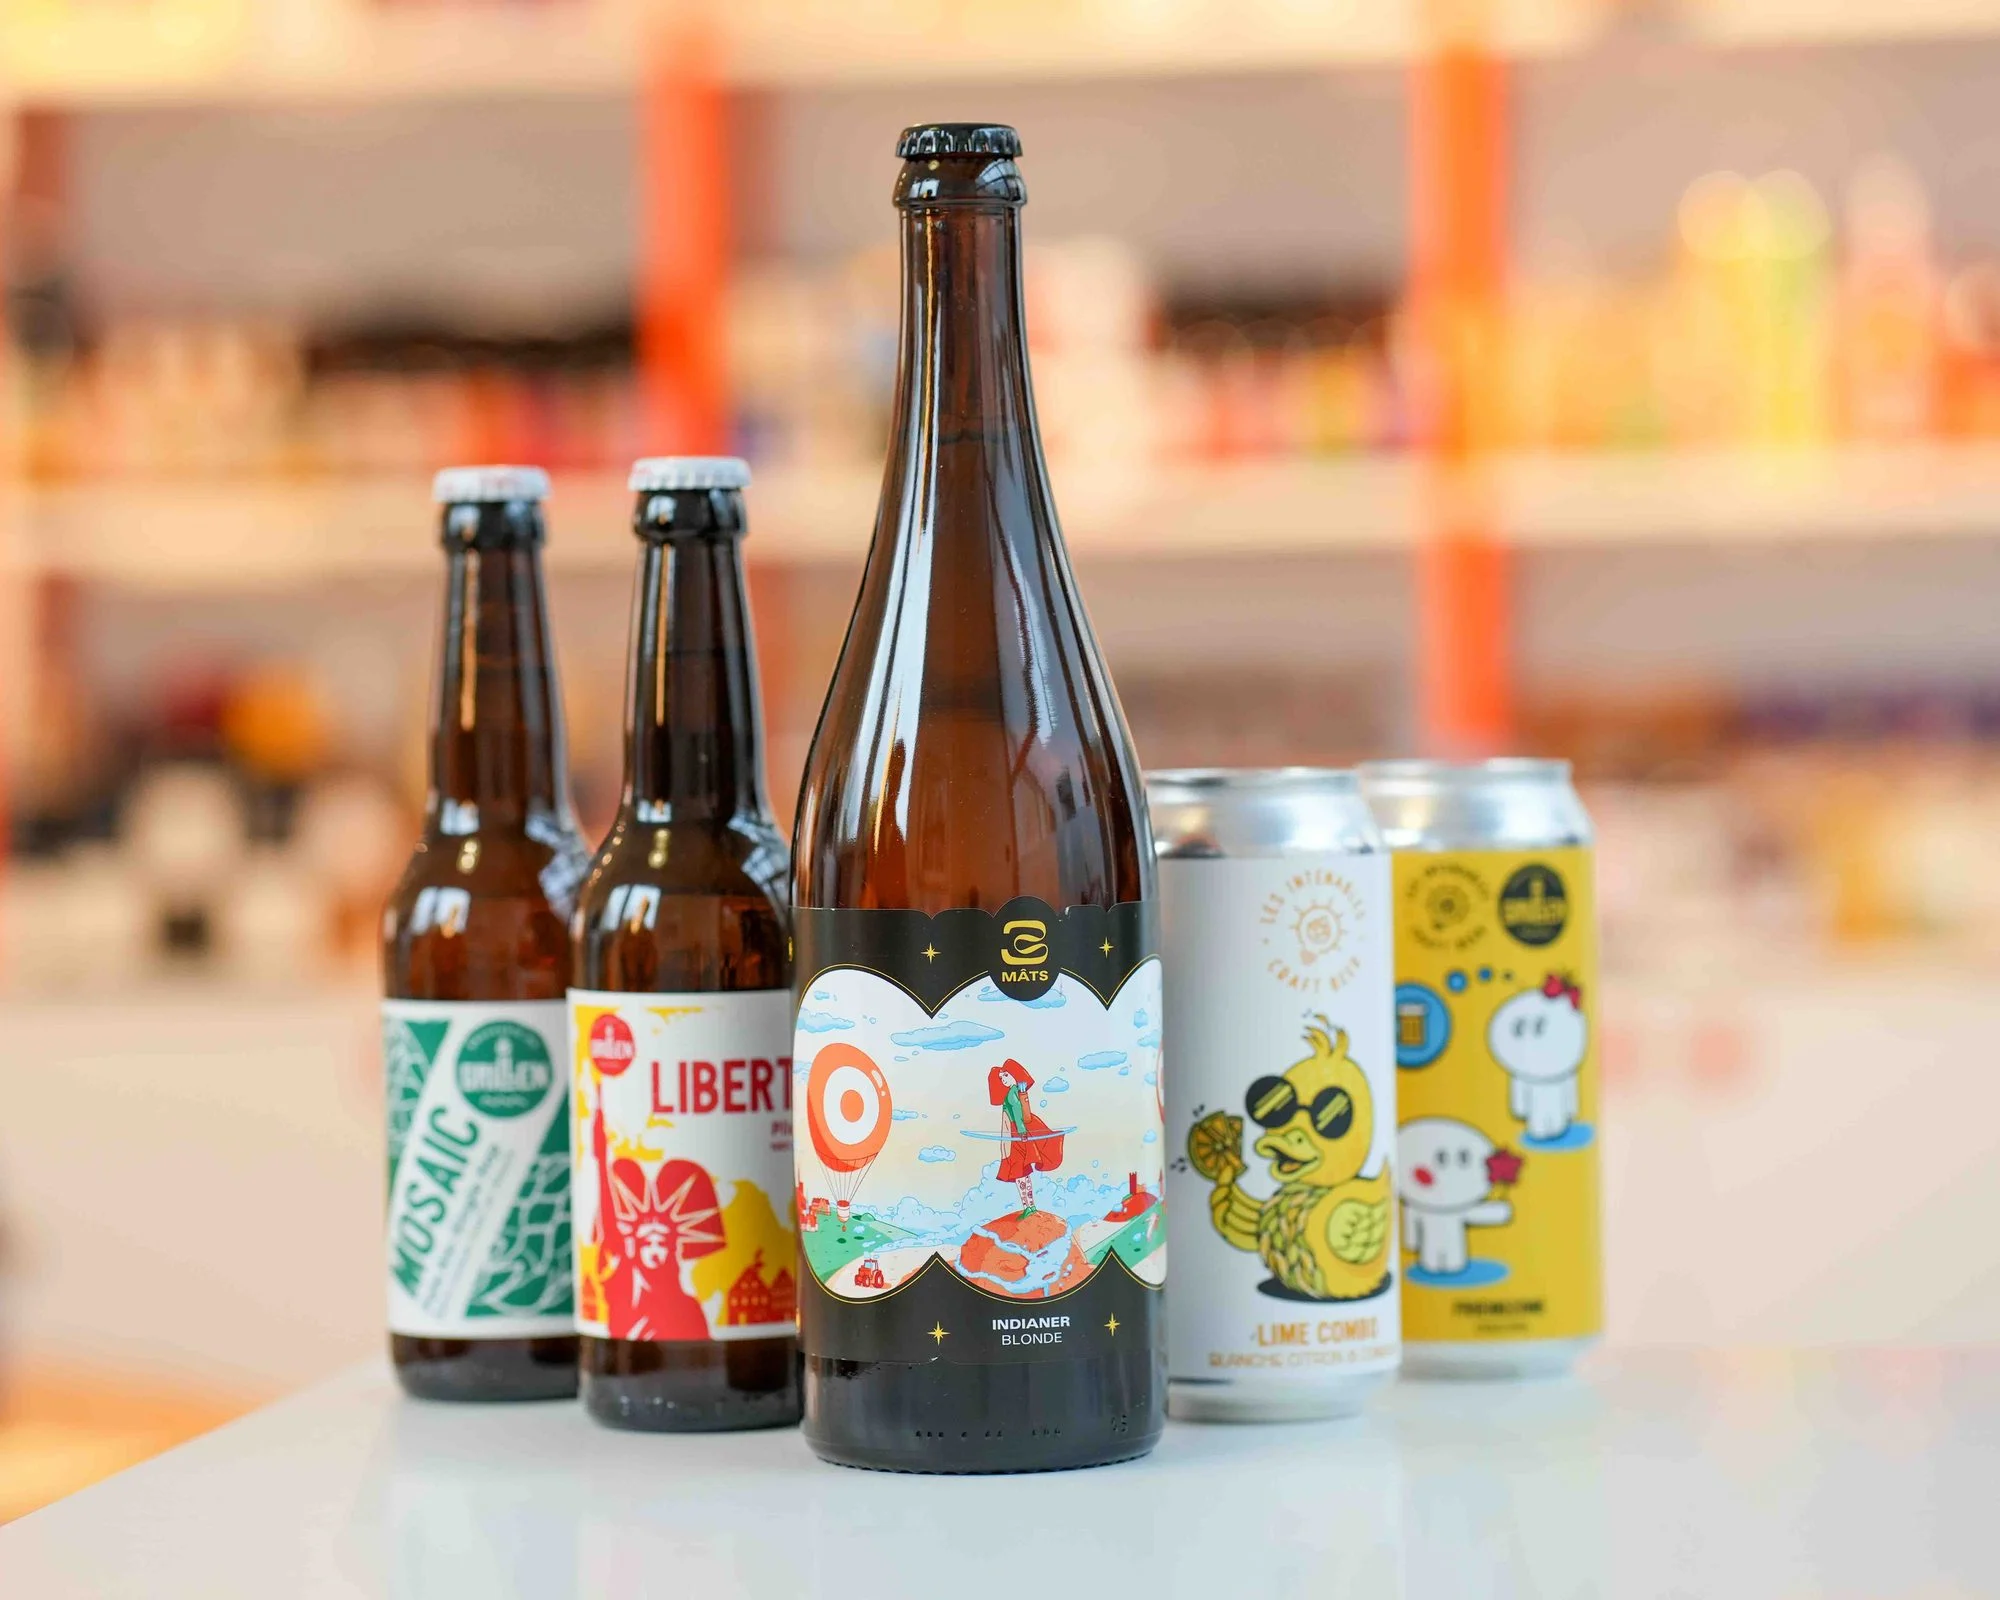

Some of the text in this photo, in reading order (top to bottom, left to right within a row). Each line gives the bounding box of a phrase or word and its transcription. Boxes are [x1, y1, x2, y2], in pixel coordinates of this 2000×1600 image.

[1001, 968, 1049, 982] MÂTS
[391, 1106, 479, 1297] MOSAIC
[992, 1316, 1071, 1331] INDIANER
[1001, 1332, 1063, 1346] BLONDE
[1257, 1321, 1310, 1347] LIME
